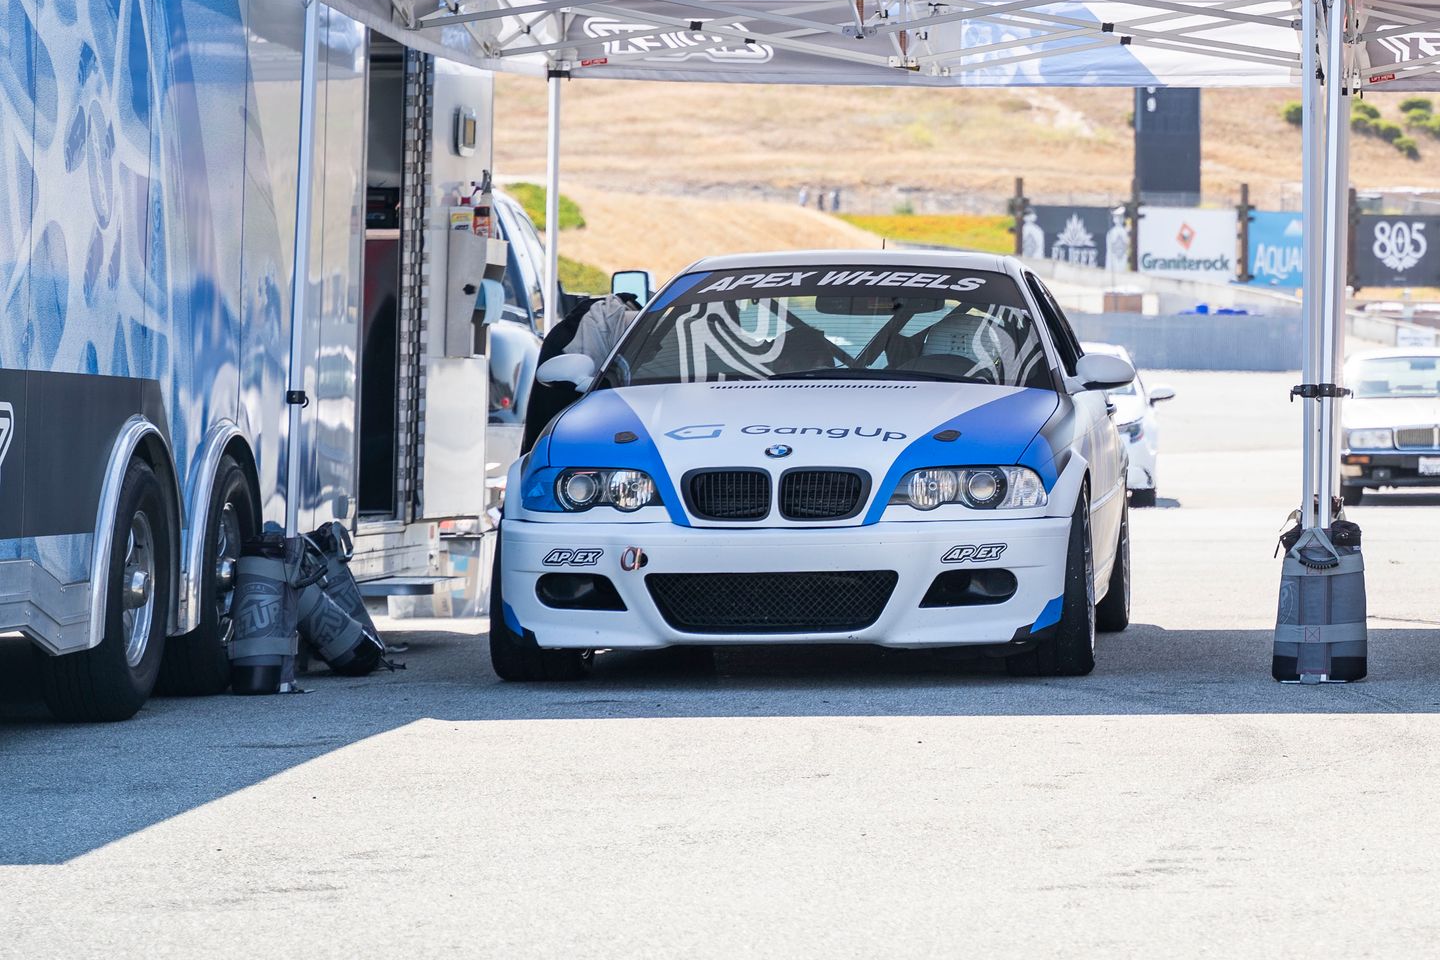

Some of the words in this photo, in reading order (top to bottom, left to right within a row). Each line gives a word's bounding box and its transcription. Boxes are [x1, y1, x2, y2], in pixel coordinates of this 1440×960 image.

[1373, 221, 1427, 259] 805
[1142, 253, 1230, 272] Graniterock
[697, 271, 817, 293] APEX
[817, 271, 986, 291] WHEELS
[741, 425, 907, 441] GangUp
[545, 550, 600, 564] APEX
[944, 545, 1003, 561] APEX
